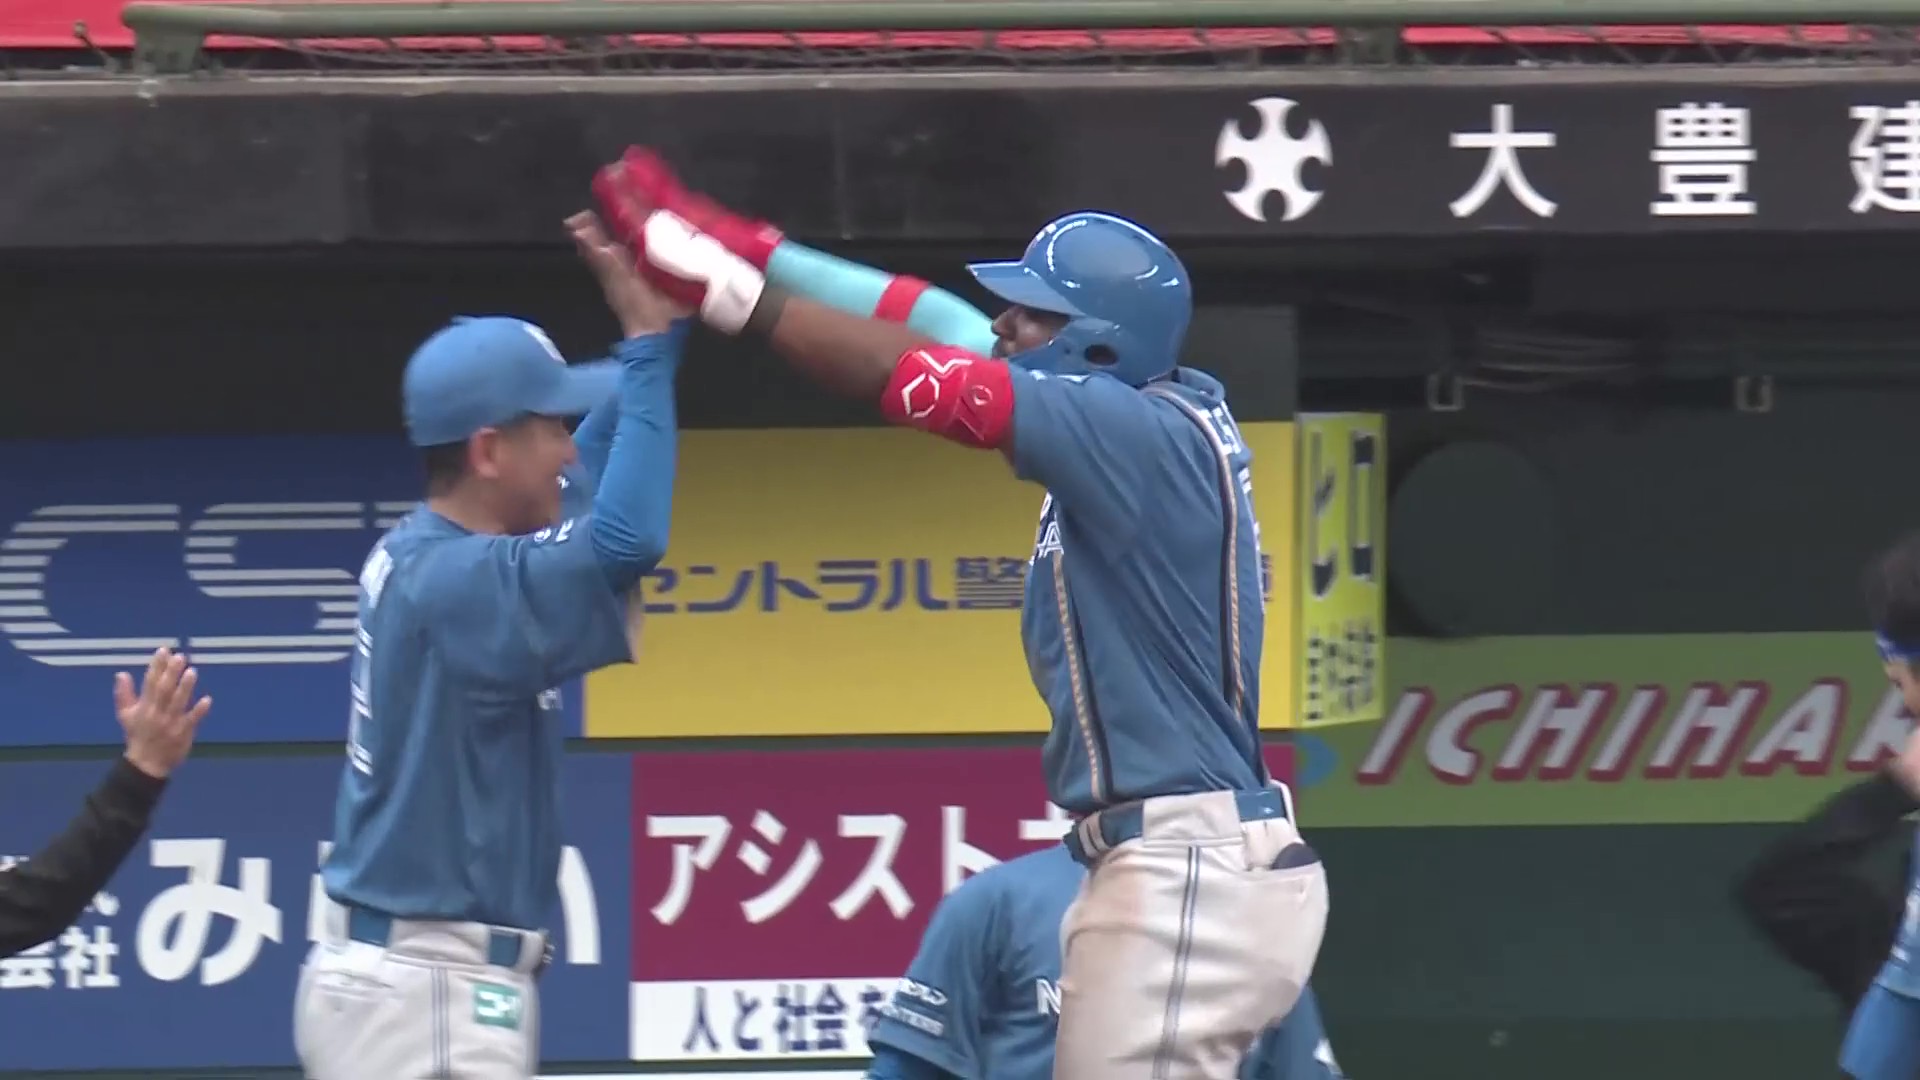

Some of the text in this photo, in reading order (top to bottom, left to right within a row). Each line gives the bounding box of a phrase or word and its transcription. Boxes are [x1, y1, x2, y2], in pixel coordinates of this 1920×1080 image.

[1, 502, 416, 666] CS
[641, 557, 1034, 613] セントラル警
